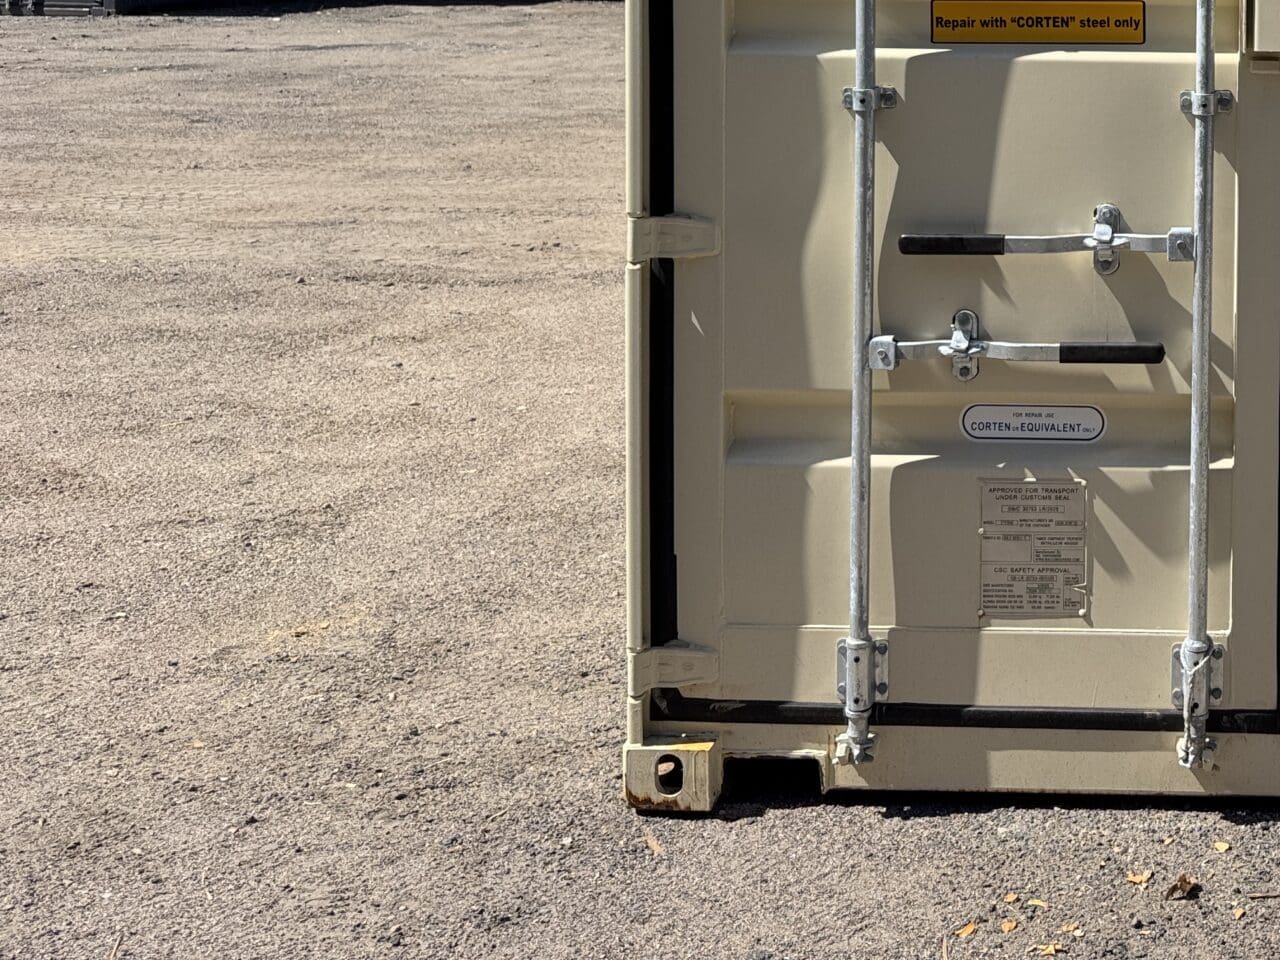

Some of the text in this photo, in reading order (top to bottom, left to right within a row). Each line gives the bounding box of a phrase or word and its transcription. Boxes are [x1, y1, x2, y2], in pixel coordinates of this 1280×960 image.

[935, 16, 976, 31] Repair
[980, 16, 1007, 28] with
[1079, 16, 1110, 29] steel
[1114, 16, 1140, 31] only
[970, 421, 1011, 432] CORTEN
[1020, 422, 1081, 433] EQUIVALENT
